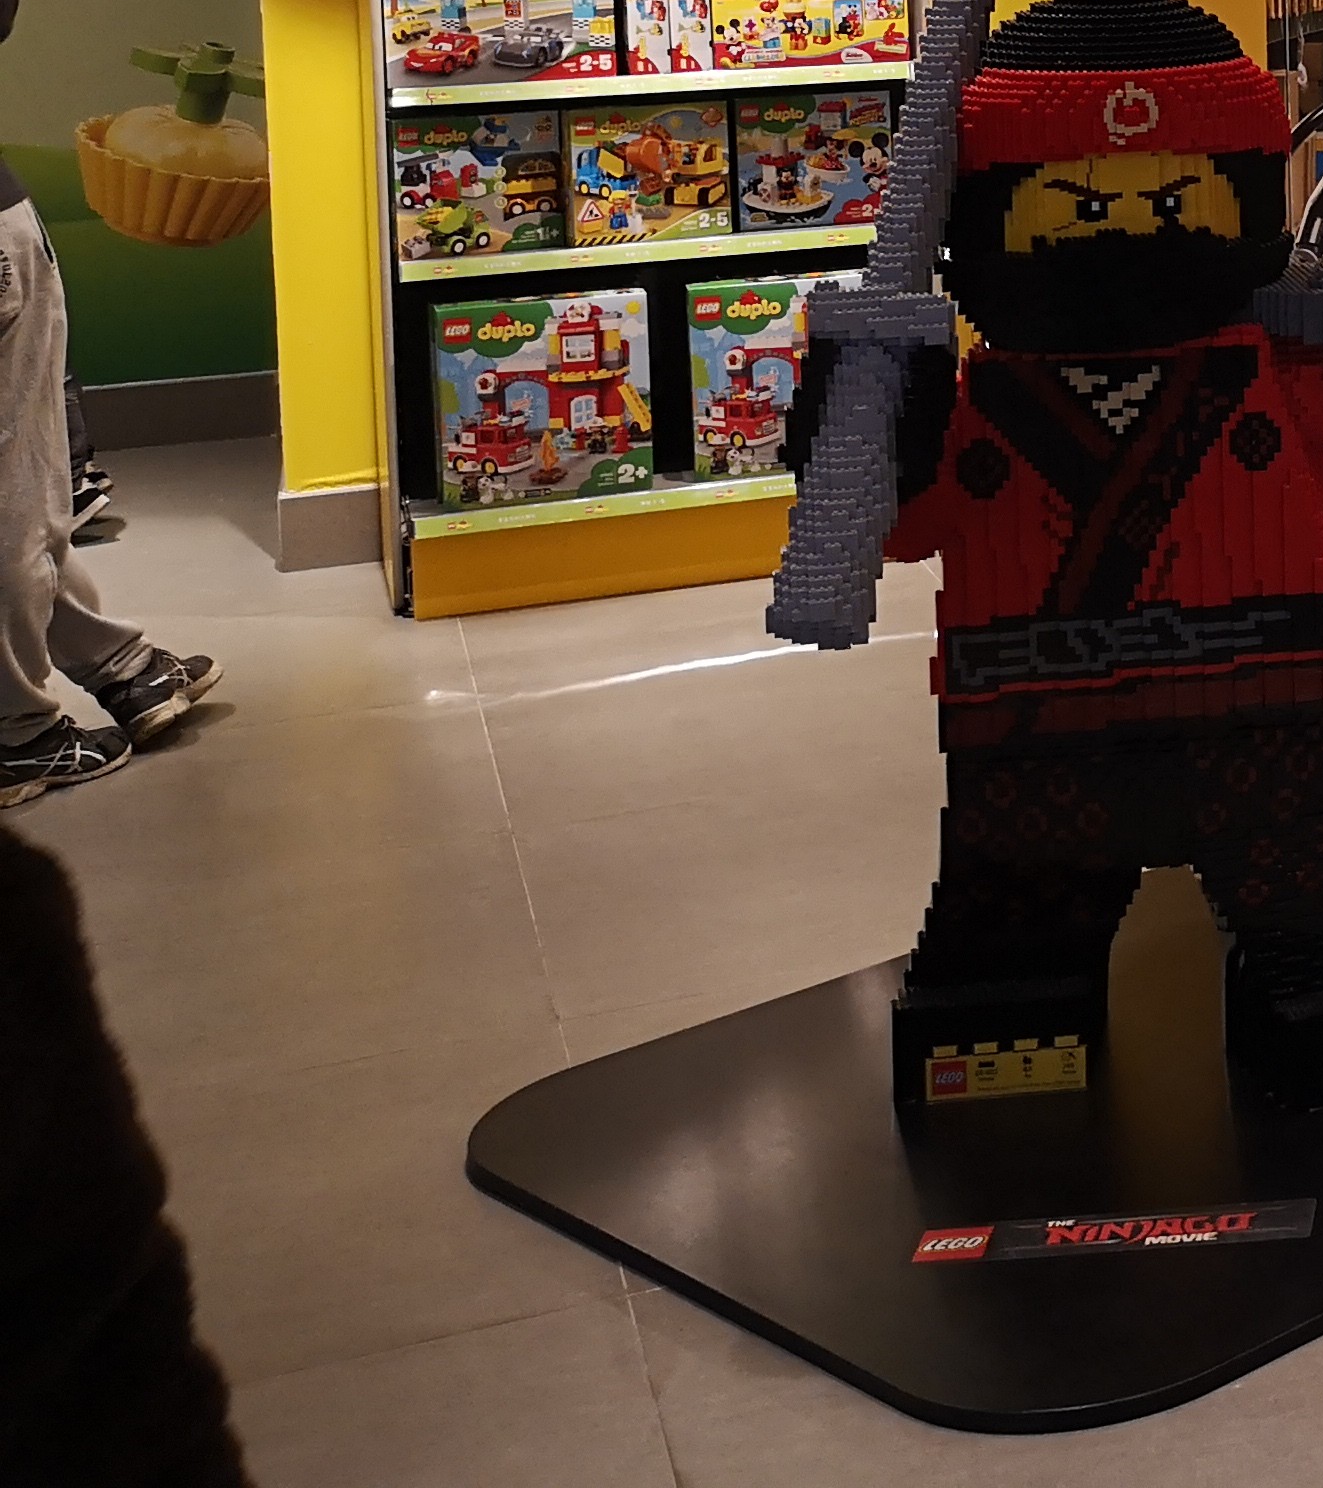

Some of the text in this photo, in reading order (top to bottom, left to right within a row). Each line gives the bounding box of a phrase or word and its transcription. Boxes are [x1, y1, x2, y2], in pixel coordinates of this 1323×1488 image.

[579, 55, 612, 71] 2-5
[764, 109, 805, 122] duplo
[600, 120, 640, 136] duplo
[424, 130, 468, 146] duplo
[699, 211, 728, 228] 2-5
[696, 299, 781, 320] LEGO duplo
[445, 320, 535, 342] LEGO duplo
[618, 464, 648, 483] 2+
[935, 1071, 966, 1085] LEGO
[1046, 1212, 1258, 1245] NINJAGO
[1047, 1218, 1076, 1228] THE
[921, 1233, 987, 1253] LEGO
[1144, 1231, 1218, 1246] MOVIE
